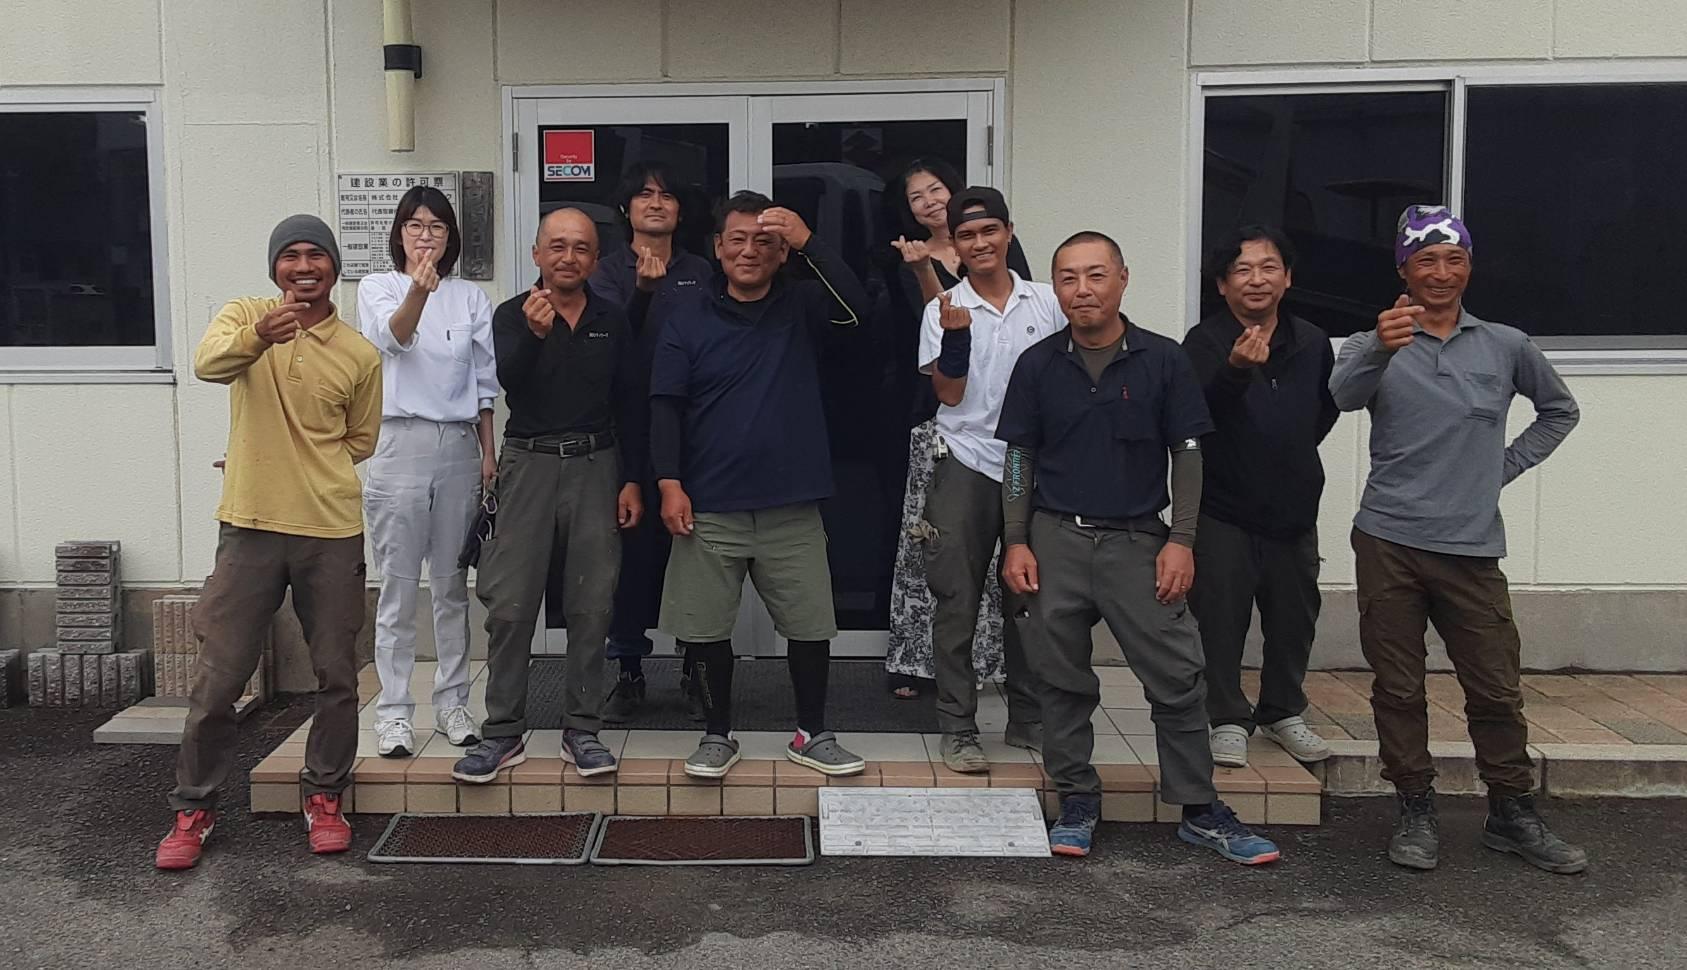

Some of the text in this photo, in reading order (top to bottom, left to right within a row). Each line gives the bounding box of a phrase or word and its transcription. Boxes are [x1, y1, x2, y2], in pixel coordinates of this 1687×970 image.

[547, 165, 591, 176] SECOM
[350, 177, 444, 188] 建設業の許可票
